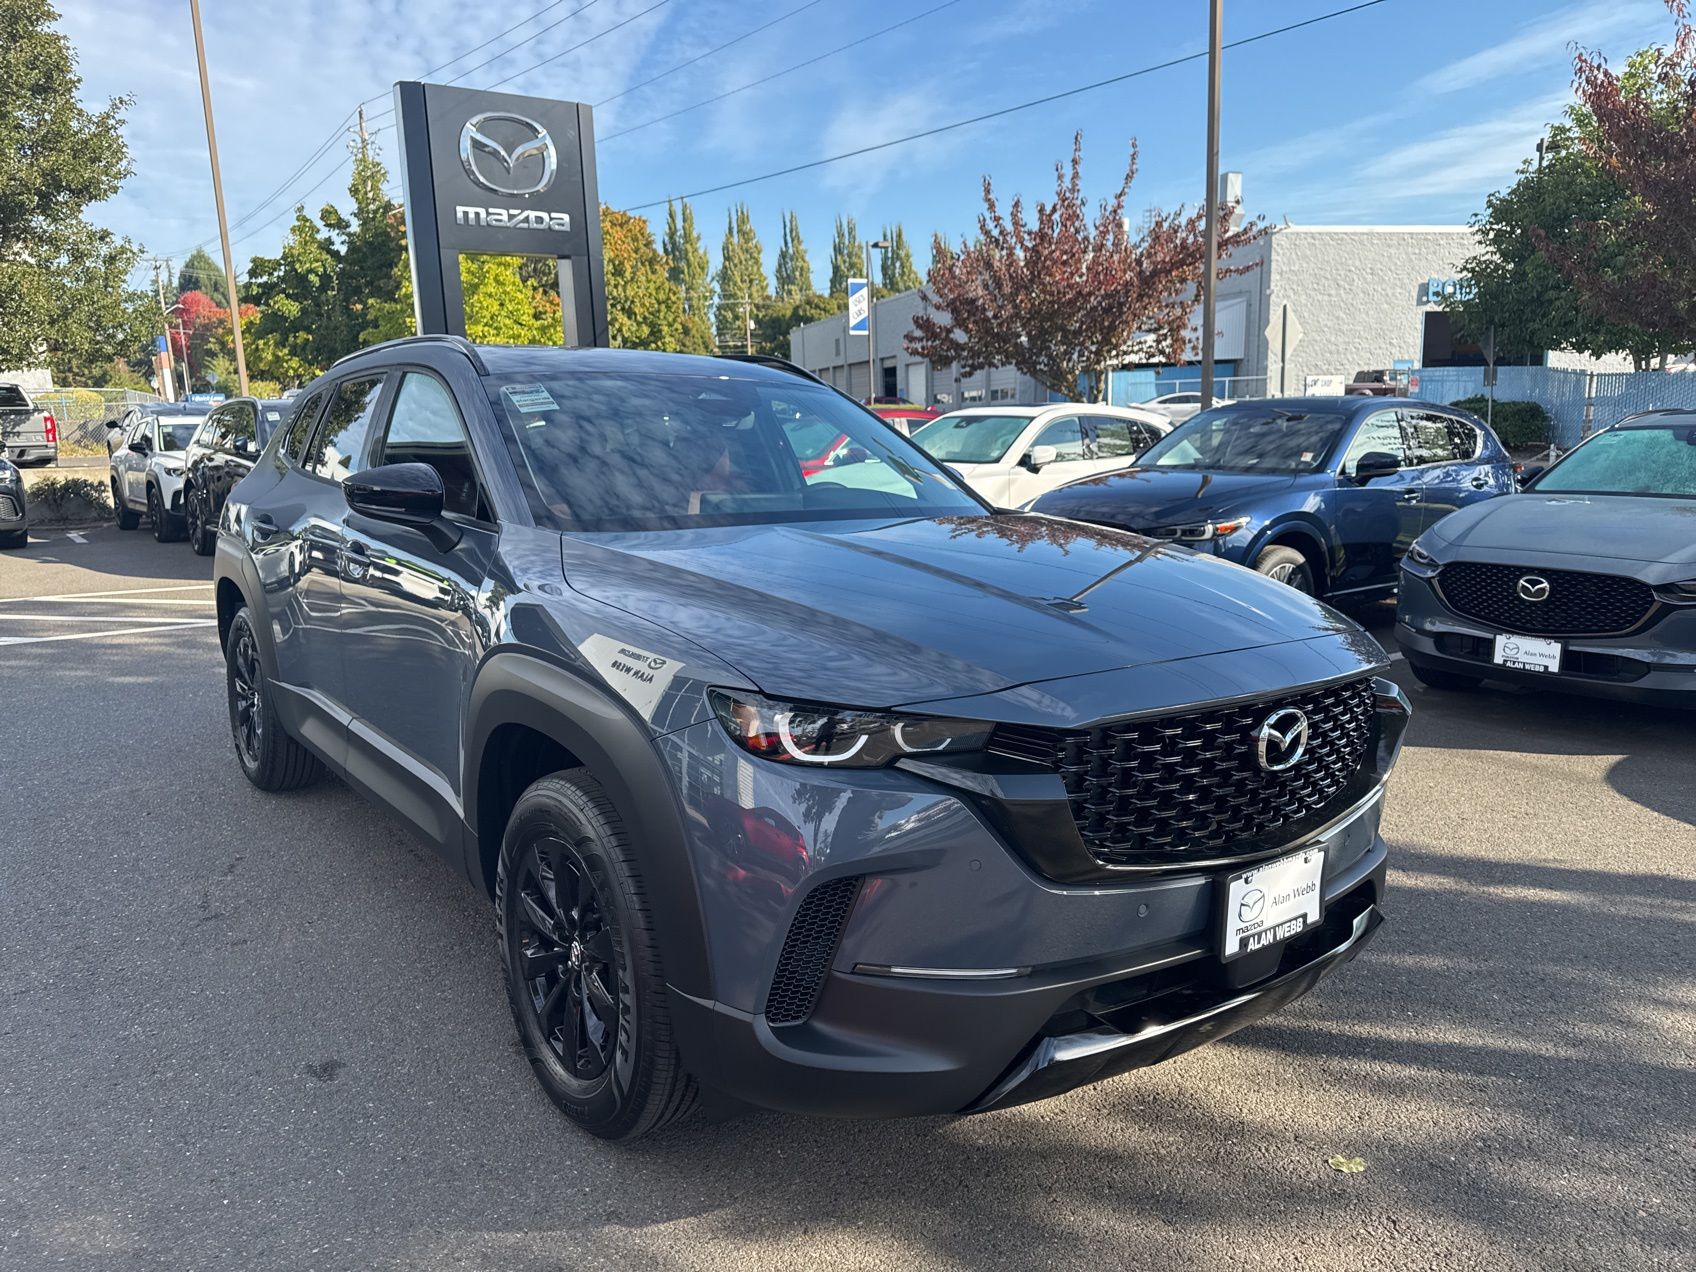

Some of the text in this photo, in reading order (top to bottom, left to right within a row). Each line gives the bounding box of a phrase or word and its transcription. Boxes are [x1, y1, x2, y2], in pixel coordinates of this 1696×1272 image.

[455, 205, 571, 232] mazda
[1506, 660, 1545, 672] ALAN WEBB
[1270, 881, 1316, 908] Alan Webb
[1235, 920, 1264, 936] mazda
[1247, 918, 1304, 952] ALAN WEBB
